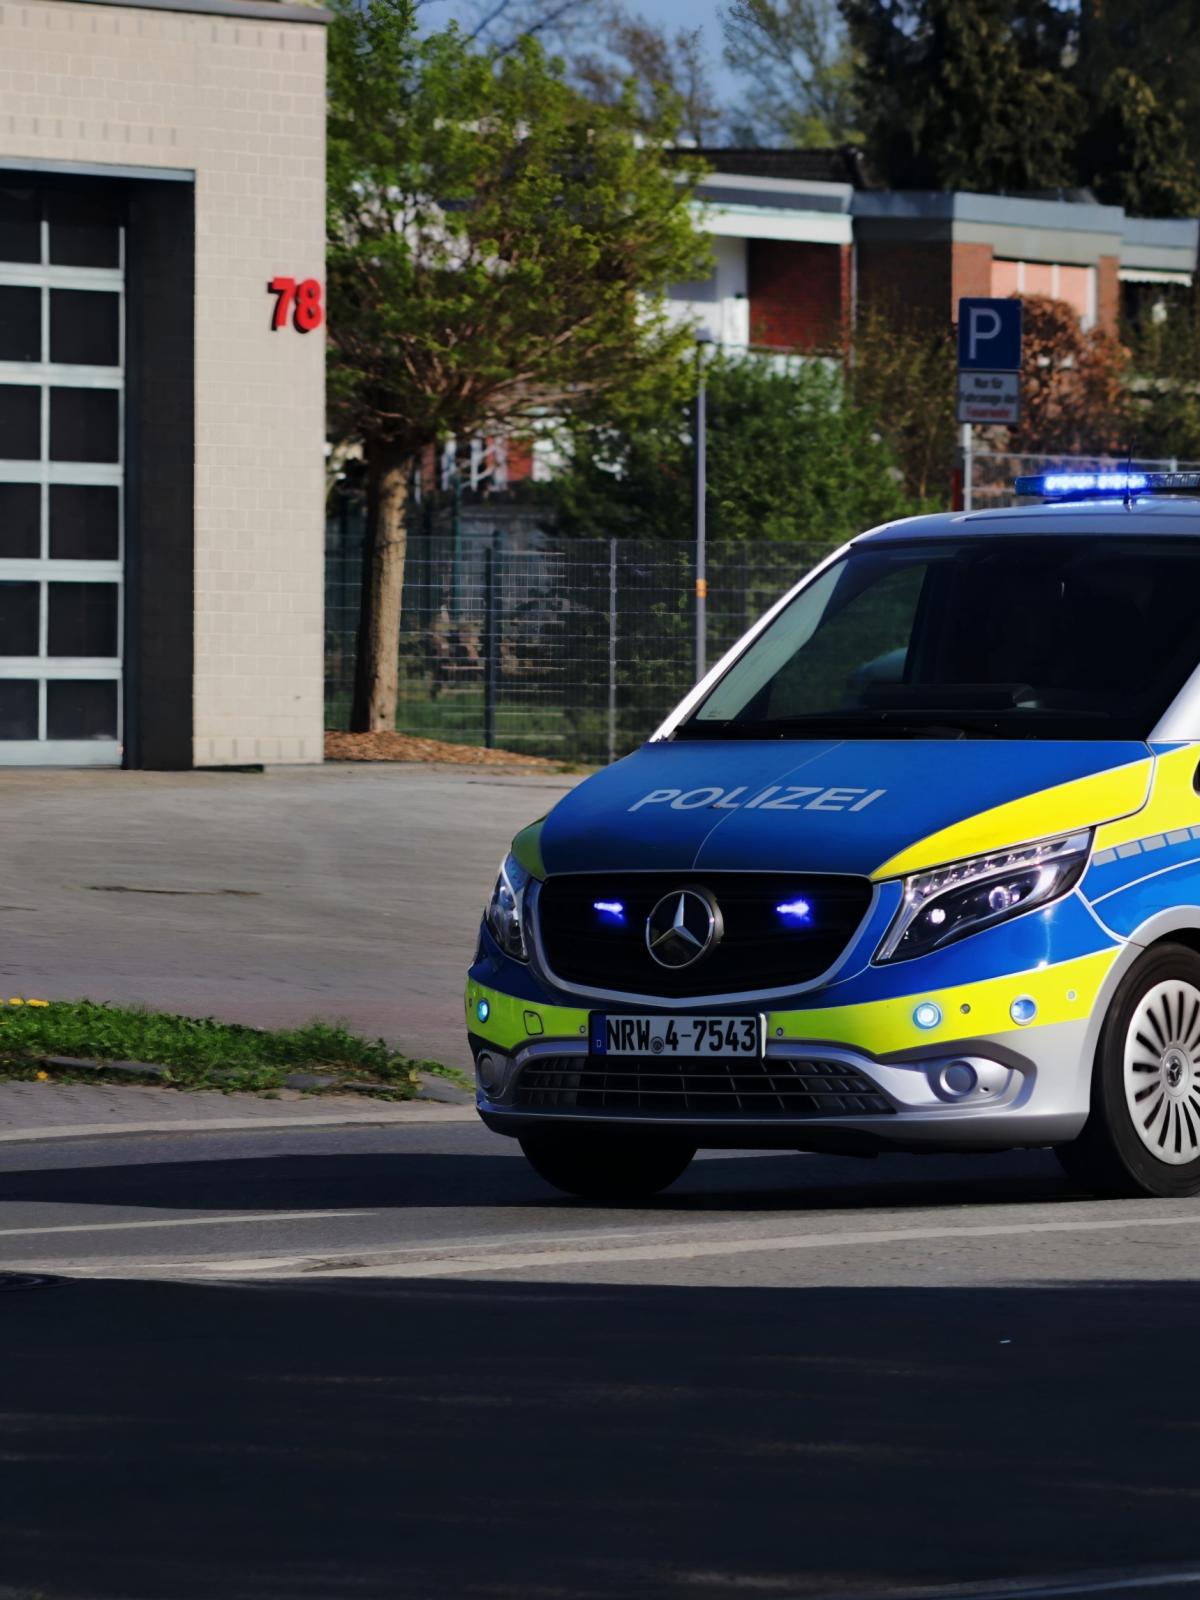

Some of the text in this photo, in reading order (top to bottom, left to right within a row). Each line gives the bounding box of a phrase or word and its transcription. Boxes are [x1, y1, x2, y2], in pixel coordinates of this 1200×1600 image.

[267, 276, 323, 334] 78
[968, 307, 1002, 360] P
[627, 786, 888, 812] POLIZEI
[607, 1019, 756, 1052] NRW 4-7543
